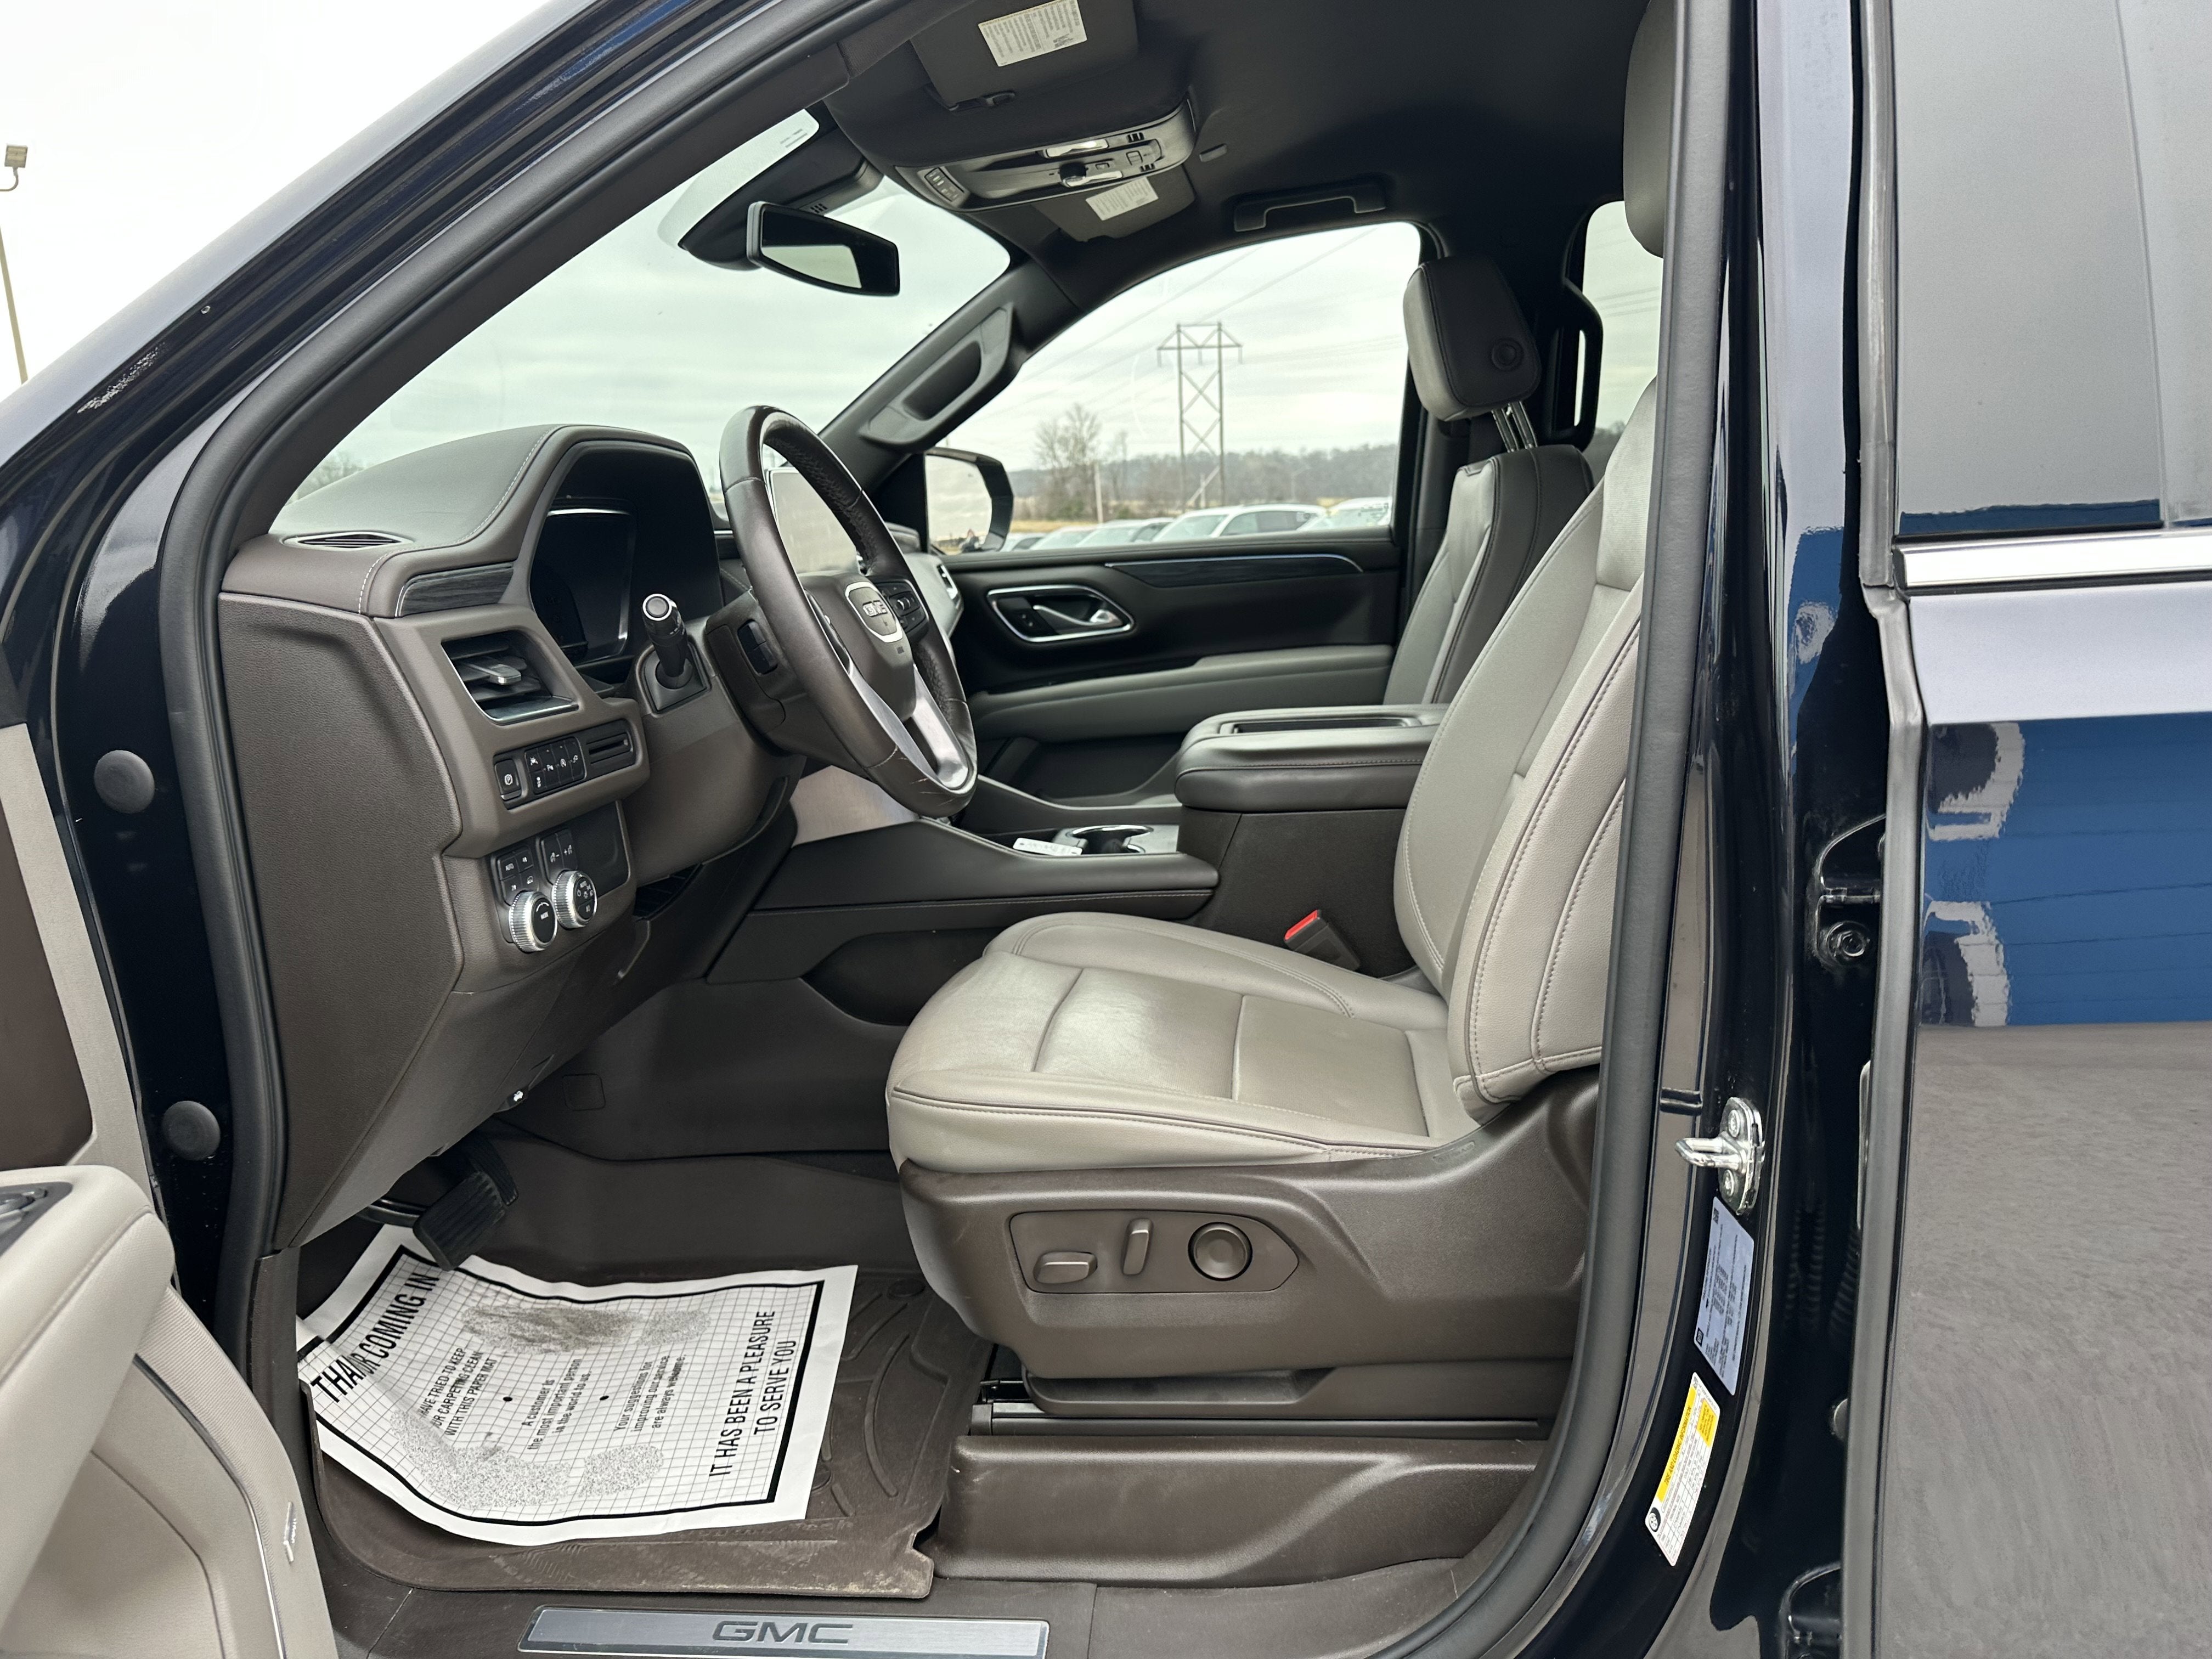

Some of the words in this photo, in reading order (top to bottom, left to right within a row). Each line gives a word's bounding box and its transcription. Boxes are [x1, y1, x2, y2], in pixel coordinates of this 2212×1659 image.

[311, 1355, 366, 1403] THA
[359, 1294, 426, 1358] COMING
[404, 1272, 439, 1291] IN
[740, 1311, 776, 1373] PLEASURE
[448, 1348, 466, 1365] KEEP
[771, 1340, 797, 1366] YOU
[442, 1365, 456, 1374] TO
[563, 1359, 582, 1381] person
[736, 1375, 757, 1384] A
[427, 1376, 450, 1397] TRIED
[437, 1373, 470, 1414] CARPETING
[462, 1351, 484, 1373] CLEAN
[760, 1367, 789, 1411] SERVE
[444, 1415, 465, 1436] WITH
[455, 1396, 475, 1415] THIS
[466, 1373, 488, 1395] PAPER
[481, 1357, 497, 1373] MAT
[527, 1387, 551, 1419] customer
[544, 1383, 570, 1416] important
[566, 1391, 582, 1412] world
[613, 1414, 631, 1431] Your
[624, 1372, 648, 1412] suggestions
[639, 1362, 653, 1370] for
[630, 1394, 657, 1432] improving
[648, 1381, 659, 1392] our
[656, 1389, 674, 1414] always
[724, 1388, 754, 1424] BEEN
[537, 1418, 553, 1436] most
[552, 1425, 566, 1434] in
[557, 1413, 572, 1424] the
[652, 1416, 664, 1429] are
[753, 1415, 778, 1435] TO
[527, 1438, 543, 1449] the
[714, 1428, 743, 1458] HAS
[1671, 1437, 1681, 1464] LOADING
[1678, 1404, 1692, 1441] INFORMATION
[709, 1464, 732, 1477] IT
[712, 1621, 853, 1644] GMC
